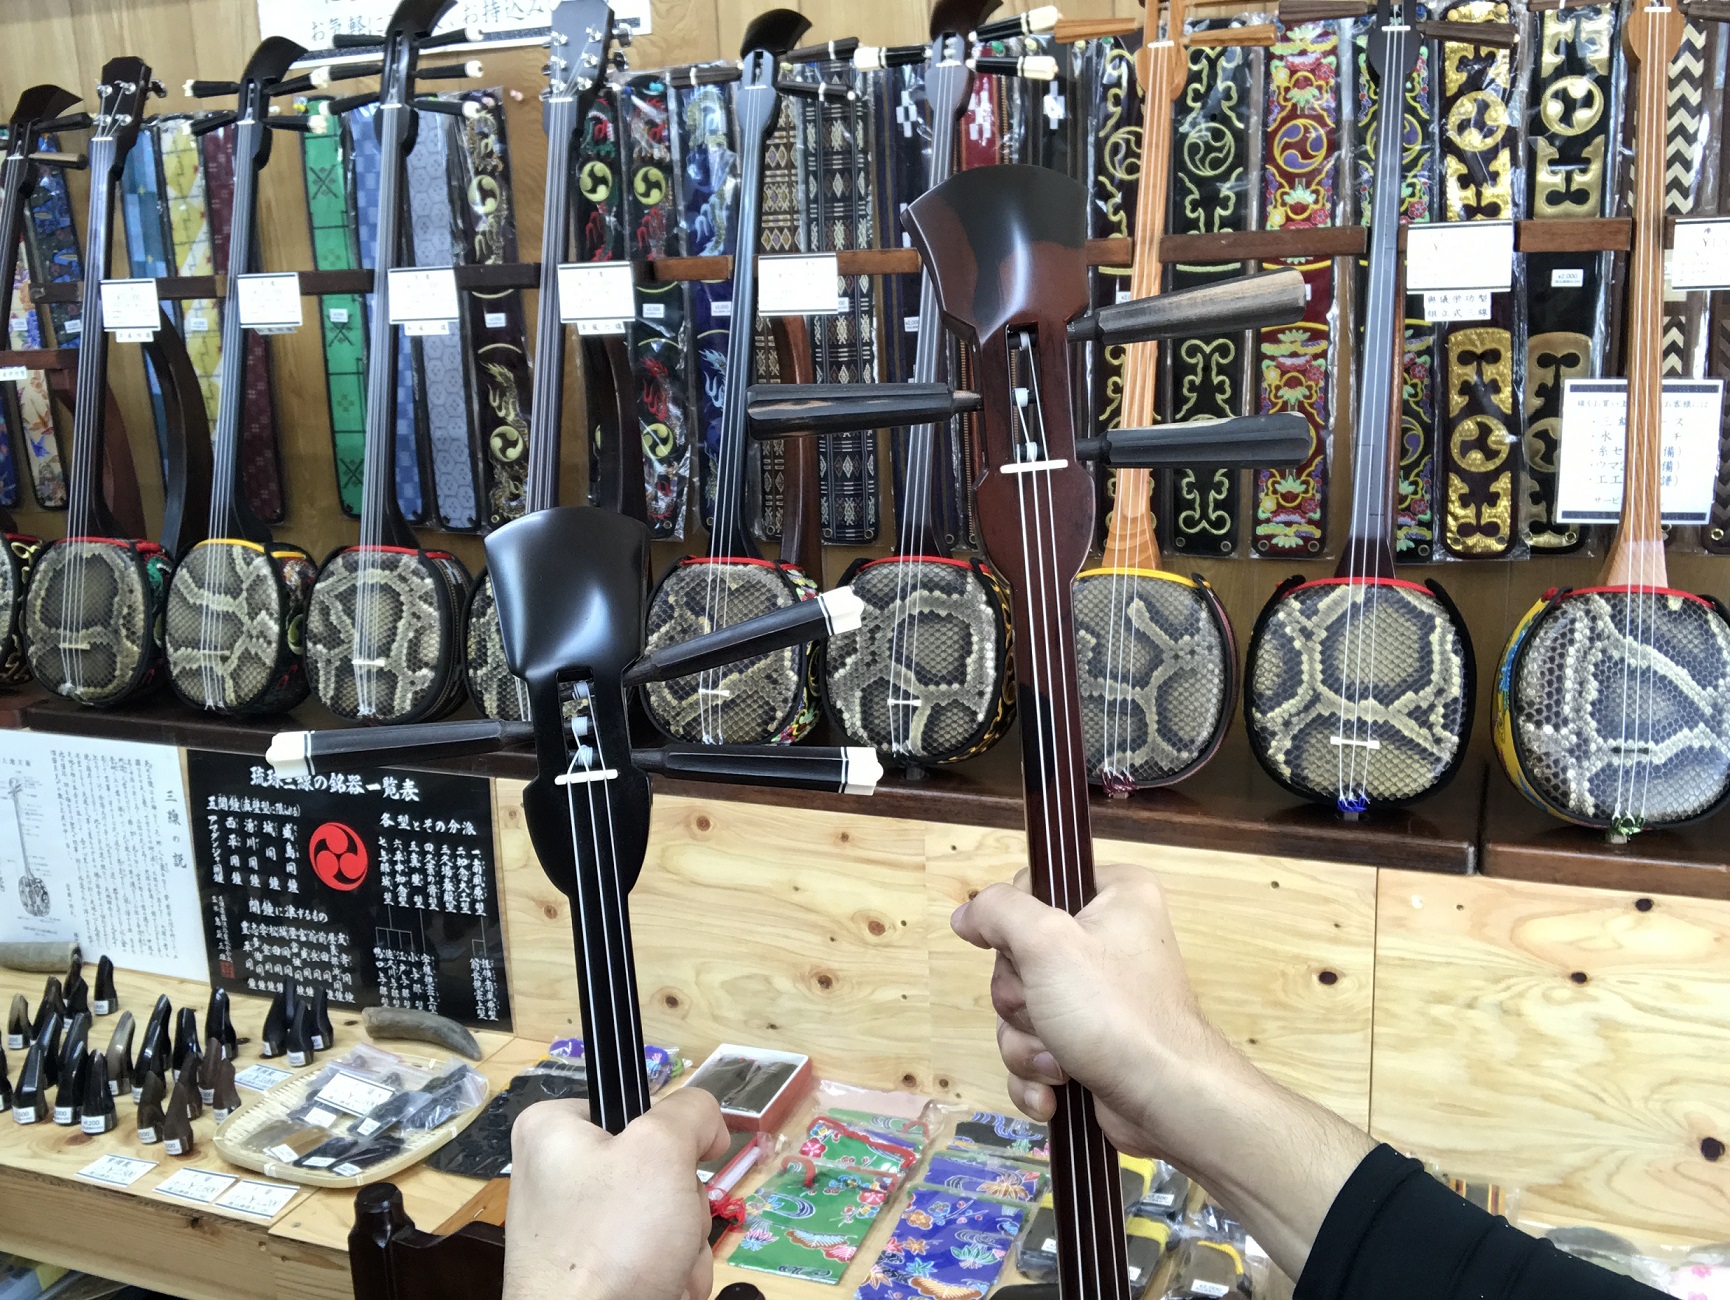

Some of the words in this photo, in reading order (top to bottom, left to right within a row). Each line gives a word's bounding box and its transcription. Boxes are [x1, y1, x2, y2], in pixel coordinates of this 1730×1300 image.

[379, 812, 477, 835] 各型とその分派
